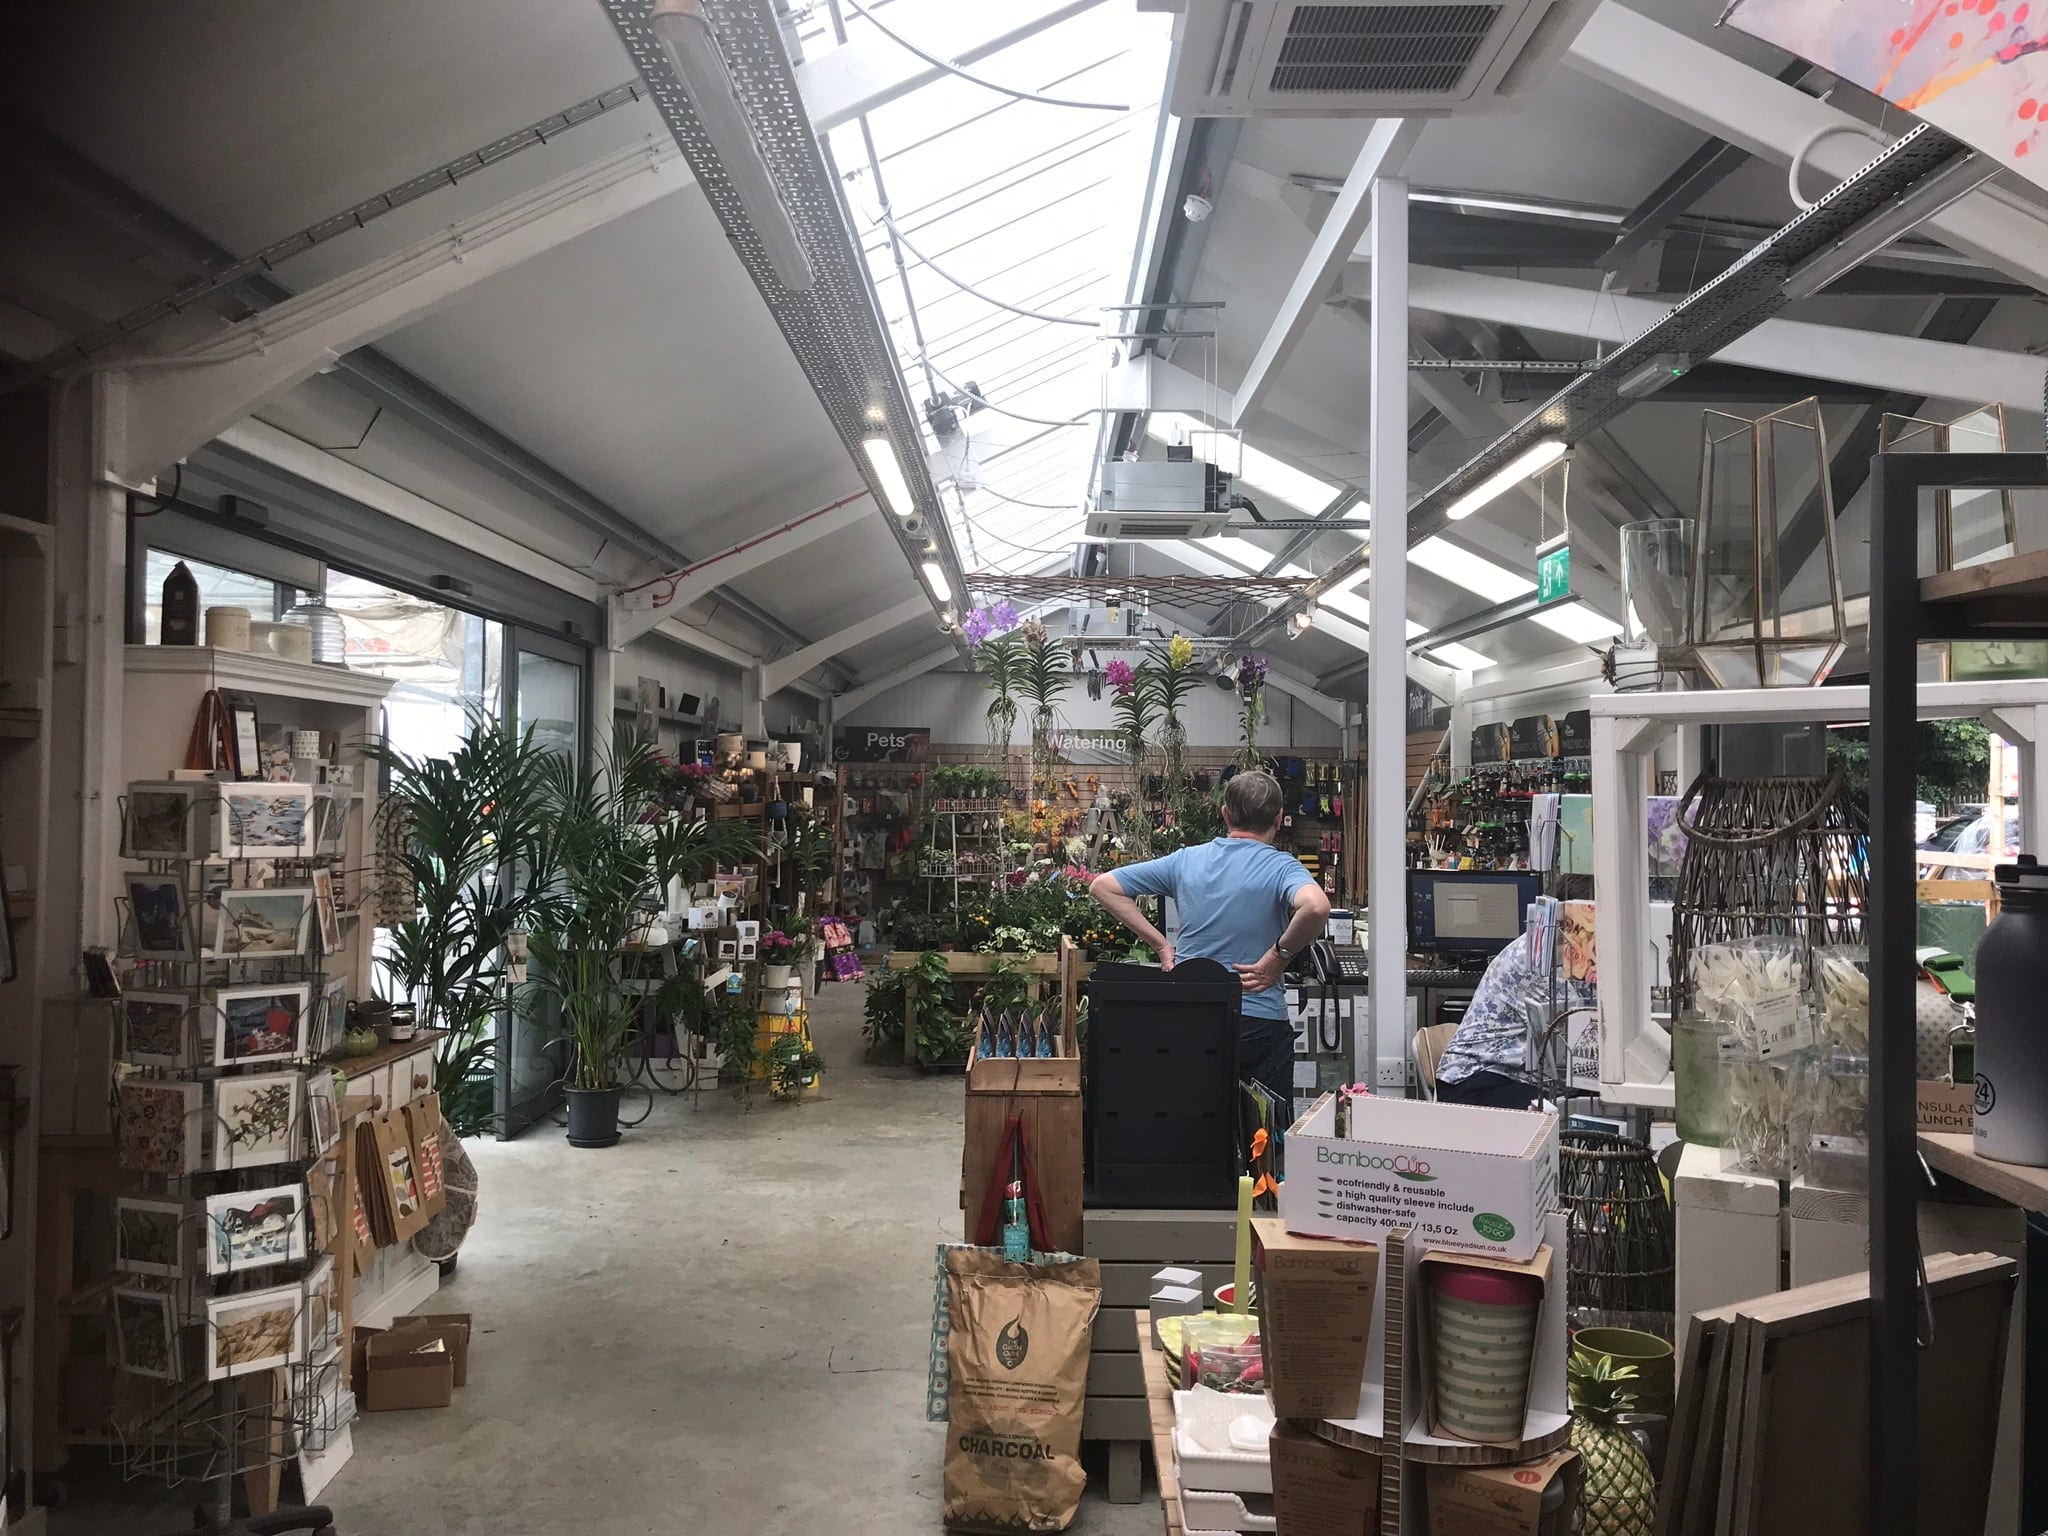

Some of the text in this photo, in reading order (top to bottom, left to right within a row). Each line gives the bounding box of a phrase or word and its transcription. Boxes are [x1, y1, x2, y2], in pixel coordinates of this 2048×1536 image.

[867, 732, 905, 747] Pets
[1049, 734, 1126, 753] Watering
[1317, 1146, 1431, 1174] BambooCup
[1337, 1178, 1445, 1197] ecofriendly & reusable
[1337, 1201, 1416, 1218] dishwasher-safe
[1345, 1191, 1366, 1201] high
[1369, 1194, 1401, 1205] quality
[1404, 1197, 1435, 1208] sleeve
[1438, 1201, 1475, 1213] include
[1337, 1214, 1377, 1227] capacity
[1380, 1218, 1397, 1228] 400
[1422, 1224, 1441, 1234] 13,5
[1444, 1226, 1458, 1236] Oz
[1492, 1228, 1506, 1238] GO
[1423, 1238, 1507, 1253] www.blueeyedsun.co.uk
[960, 1436, 1055, 1460] CHARCOAL
